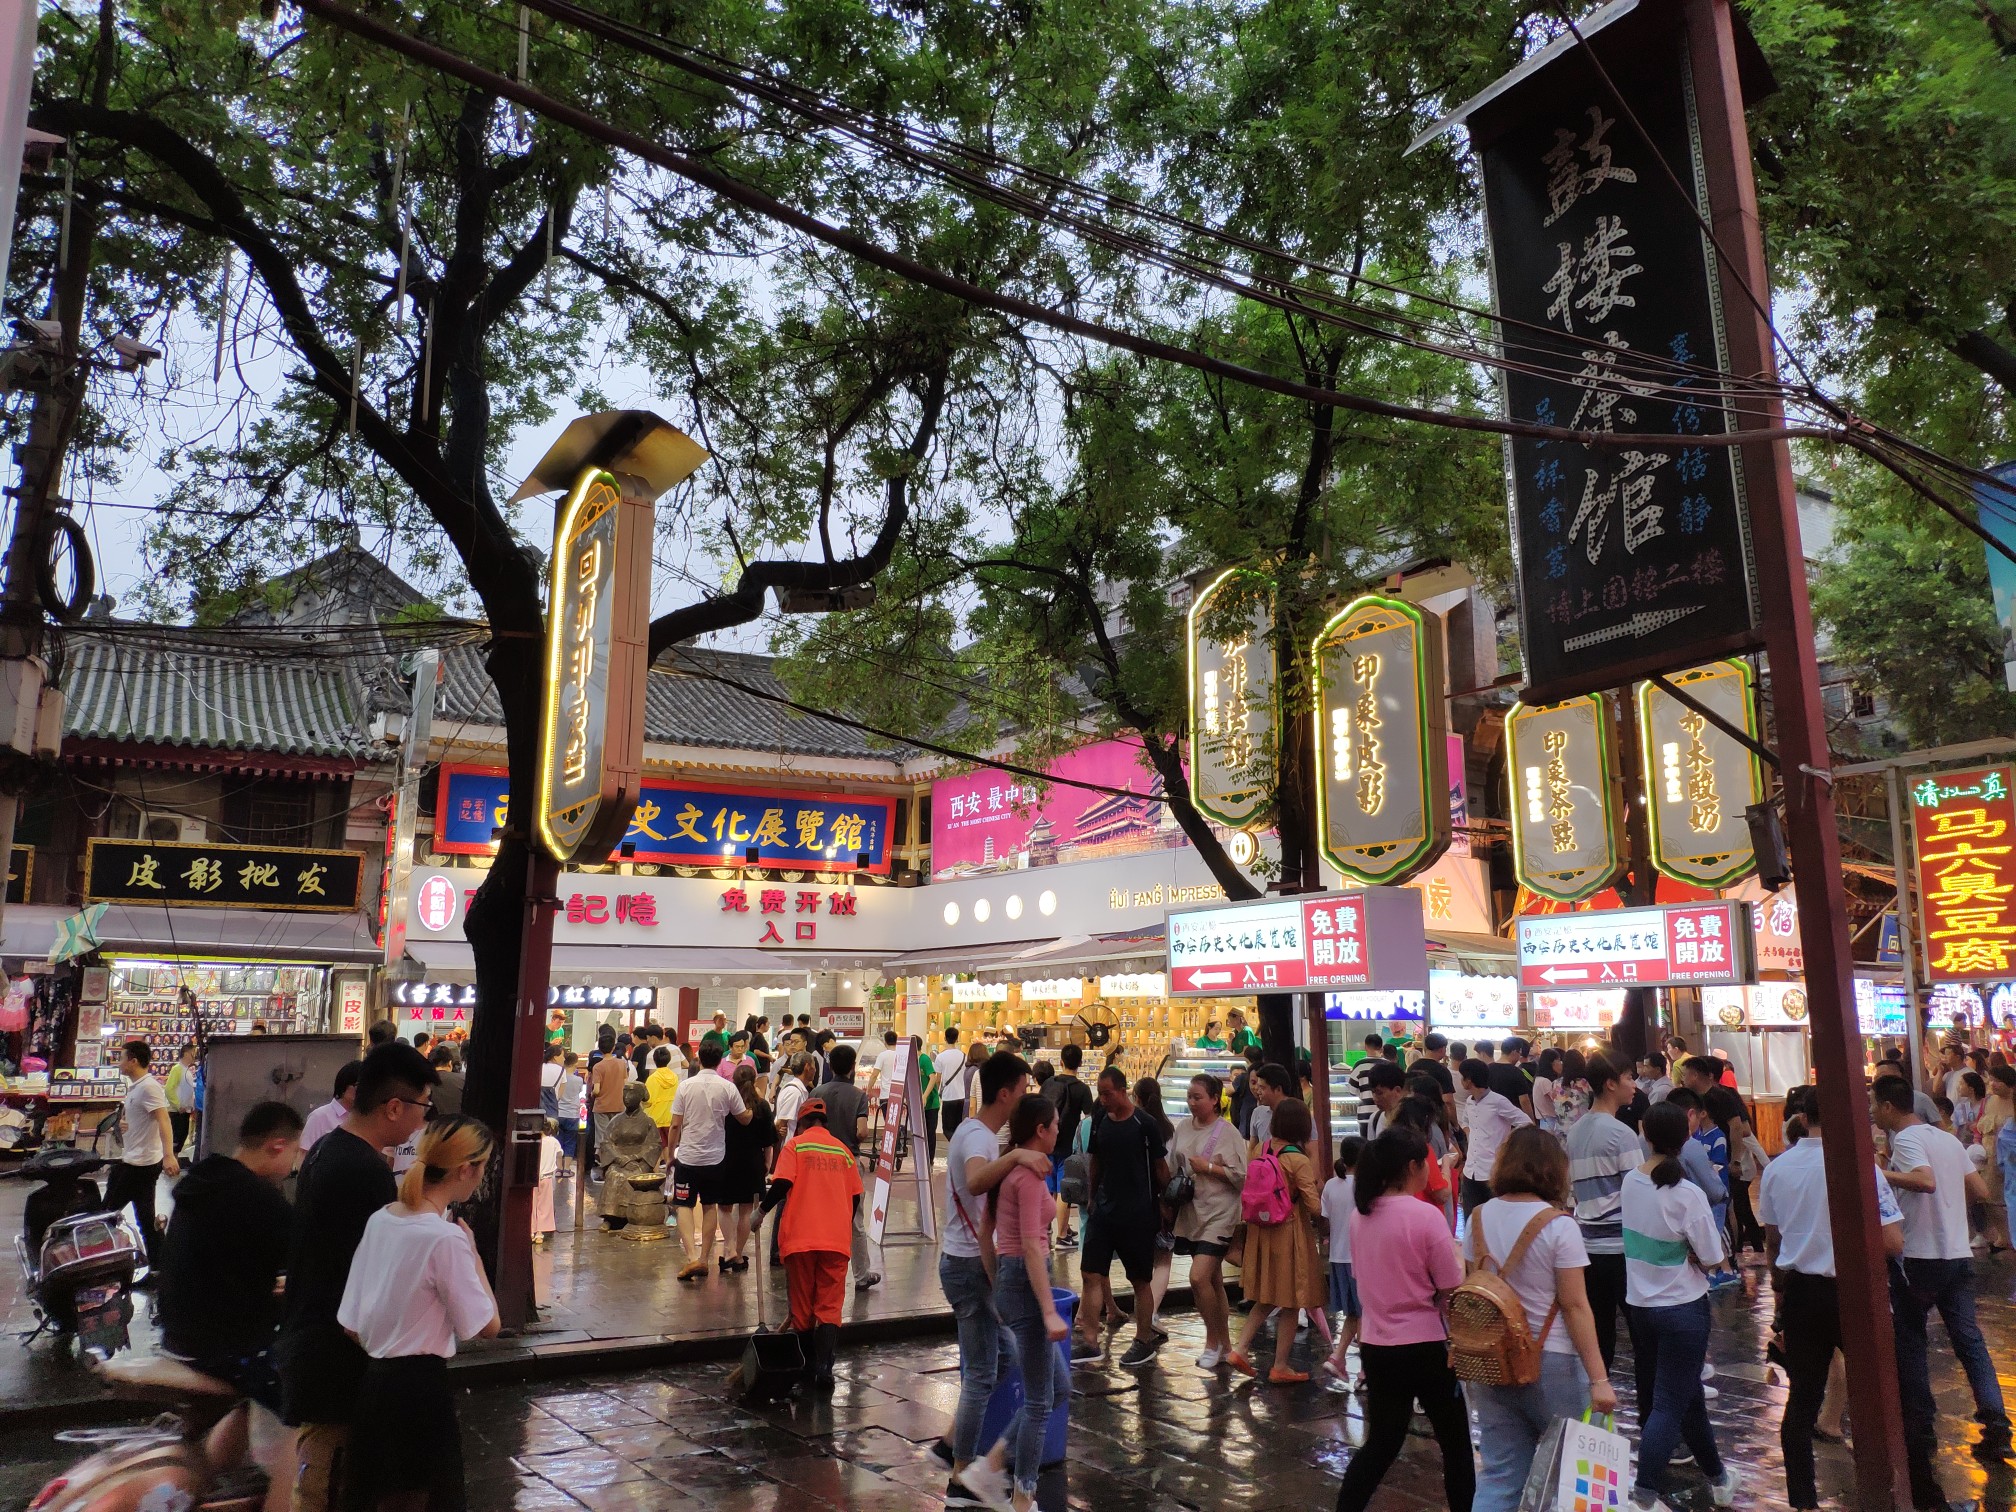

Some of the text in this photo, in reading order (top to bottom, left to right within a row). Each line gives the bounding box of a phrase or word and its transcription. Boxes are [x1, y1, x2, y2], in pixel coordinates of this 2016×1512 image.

[1542, 105, 1671, 566] 鼓楼茶馆
[1353, 653, 1384, 816] 印象皮影
[950, 792, 981, 819] 西安
[982, 815, 1000, 824] CHINESE
[126, 854, 327, 896] 皮影批发
[721, 887, 857, 916] 免费开放
[1167, 884, 1228, 904] IMPRESSI
[1921, 808, 2016, 973] 马六臭豆腐
[758, 920, 817, 944] 入口
[1311, 906, 1357, 936] 免費
[1674, 914, 1722, 939] 免費
[1312, 937, 1360, 966] 開放
[1676, 940, 1725, 964] 開放
[1243, 964, 1278, 982] 入口
[1309, 973, 1367, 985] FREE OPENING
[1600, 963, 1638, 978] 入口
[1672, 969, 1731, 980] FREE OPENING
[344, 1000, 361, 1030] 皮影
